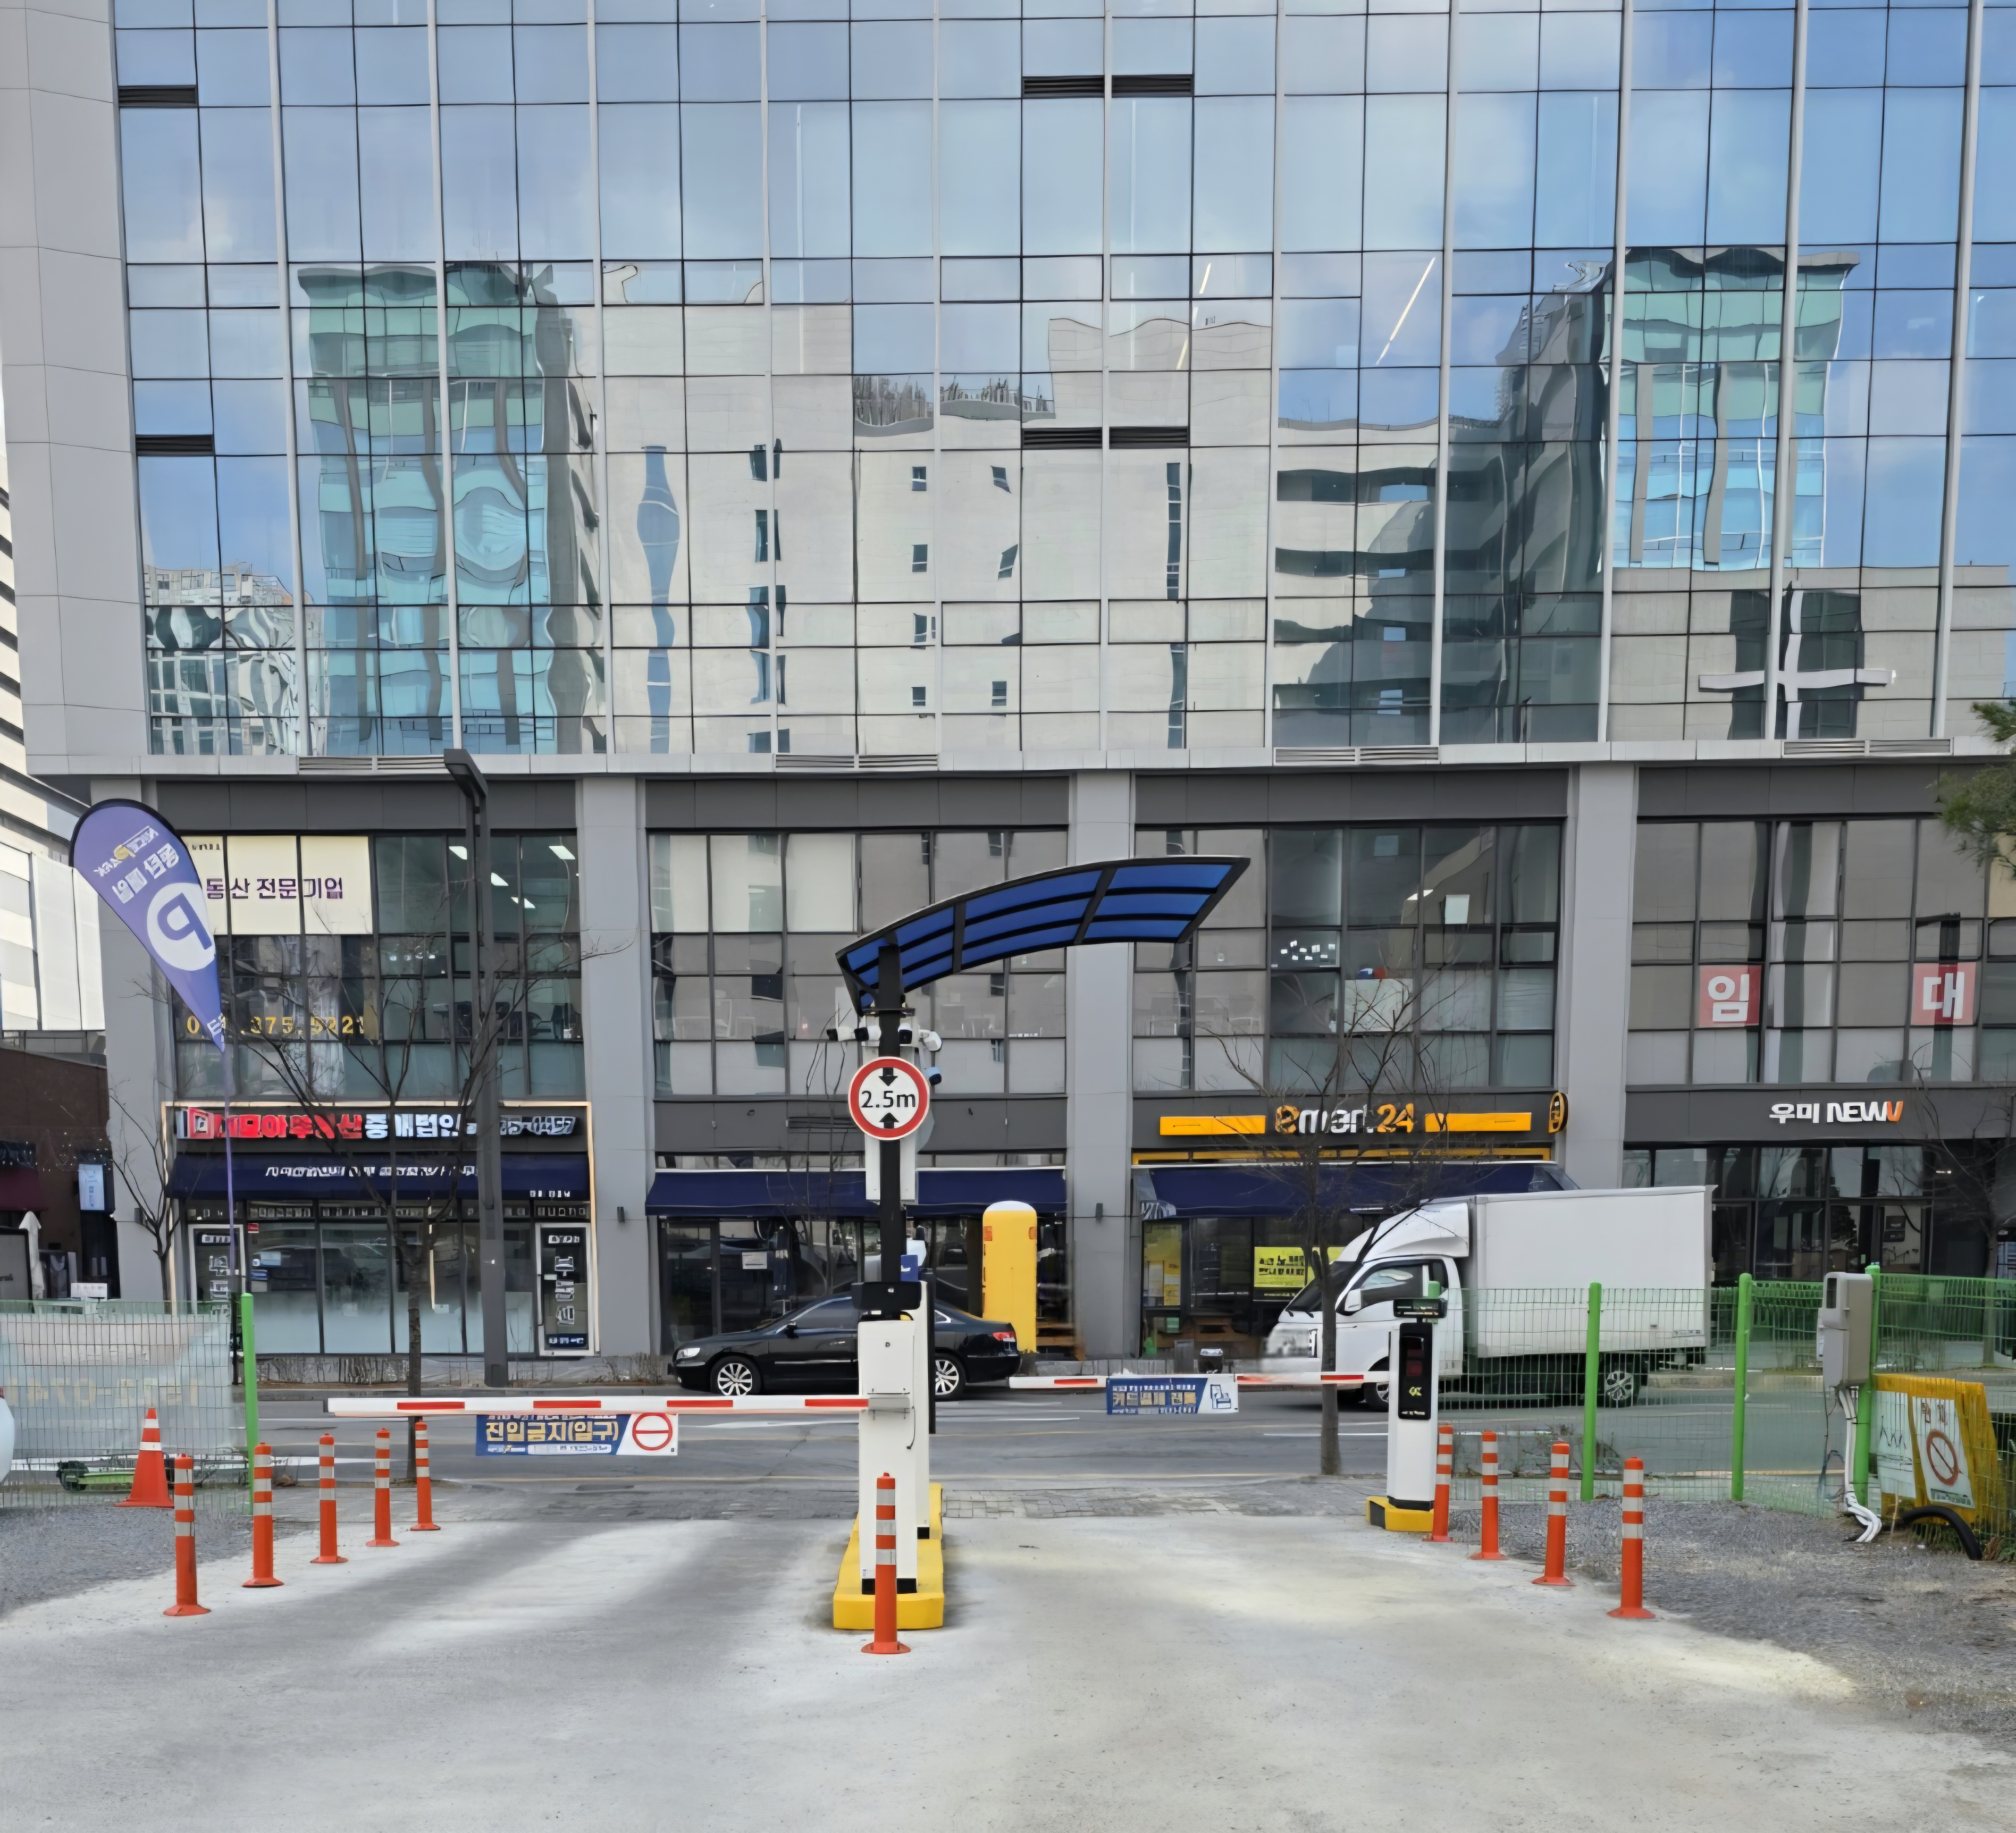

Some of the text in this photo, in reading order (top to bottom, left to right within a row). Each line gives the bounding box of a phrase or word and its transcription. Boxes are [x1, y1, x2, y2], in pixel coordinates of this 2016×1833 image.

[206, 878, 250, 899] 동산
[1708, 971, 1965, 1022] 임 대
[861, 1090, 916, 1108] 2.5m
[1769, 1103, 1820, 1124] 우미
